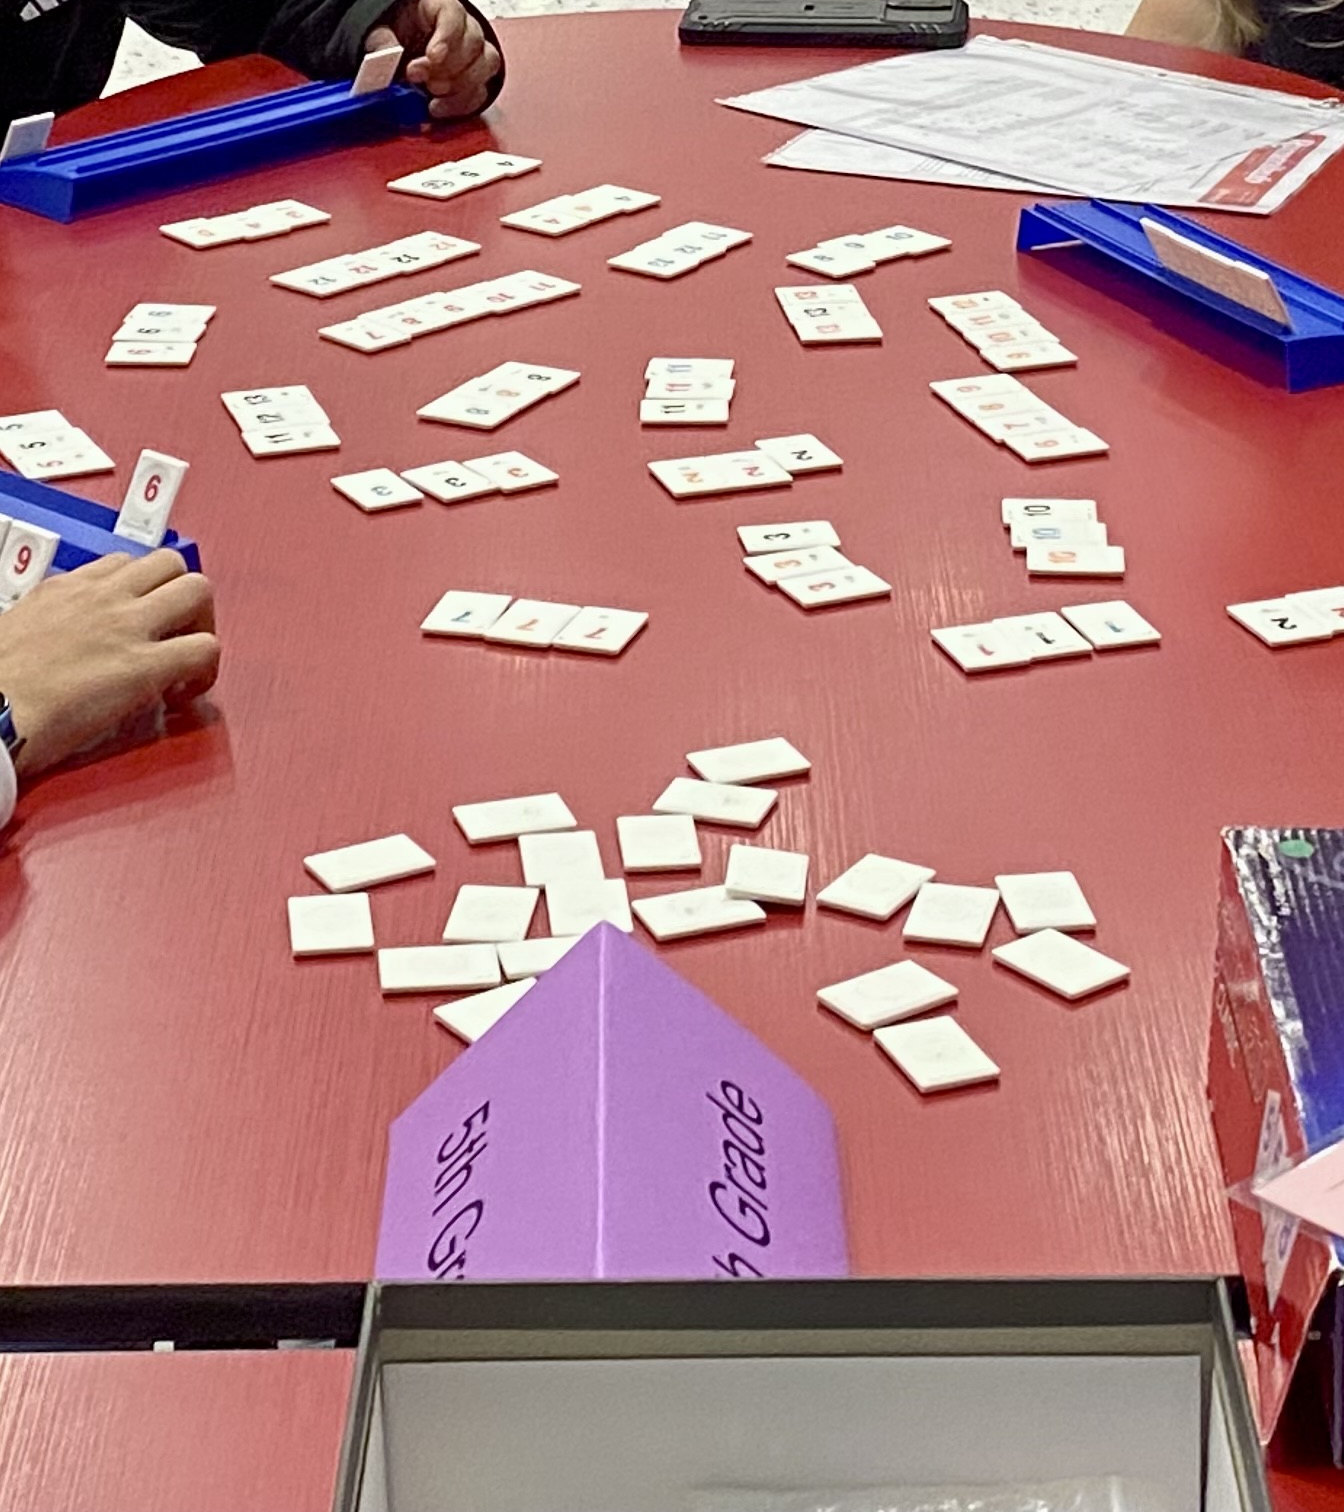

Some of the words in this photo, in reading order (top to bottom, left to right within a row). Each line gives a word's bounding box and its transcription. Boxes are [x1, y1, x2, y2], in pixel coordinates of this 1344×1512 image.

[430, 241, 456, 250] 12
[390, 254, 420, 264] 12
[349, 264, 378, 274] 12
[309, 276, 336, 286] 12
[244, 394, 272, 405] 13
[661, 404, 686, 414] 11
[264, 433, 294, 444] 11
[19, 441, 46, 449] 5
[792, 449, 813, 461] 2
[36, 460, 64, 468] 5
[507, 468, 529, 478] 3
[683, 471, 704, 483] 2
[743, 466, 765, 477] 2
[144, 474, 162, 502] 6
[444, 477, 467, 488] 3
[1023, 505, 1051, 517] 10
[763, 532, 791, 541] 3
[1032, 527, 1061, 539] 10
[14, 545, 32, 574] 9
[1048, 551, 1077, 563] 10
[774, 559, 802, 569] 3
[808, 581, 837, 592] 3
[1271, 616, 1297, 630] 2
[1036, 631, 1055, 644] 1
[432, 1100, 490, 1216] 5th
[706, 1080, 771, 1247] Grade
